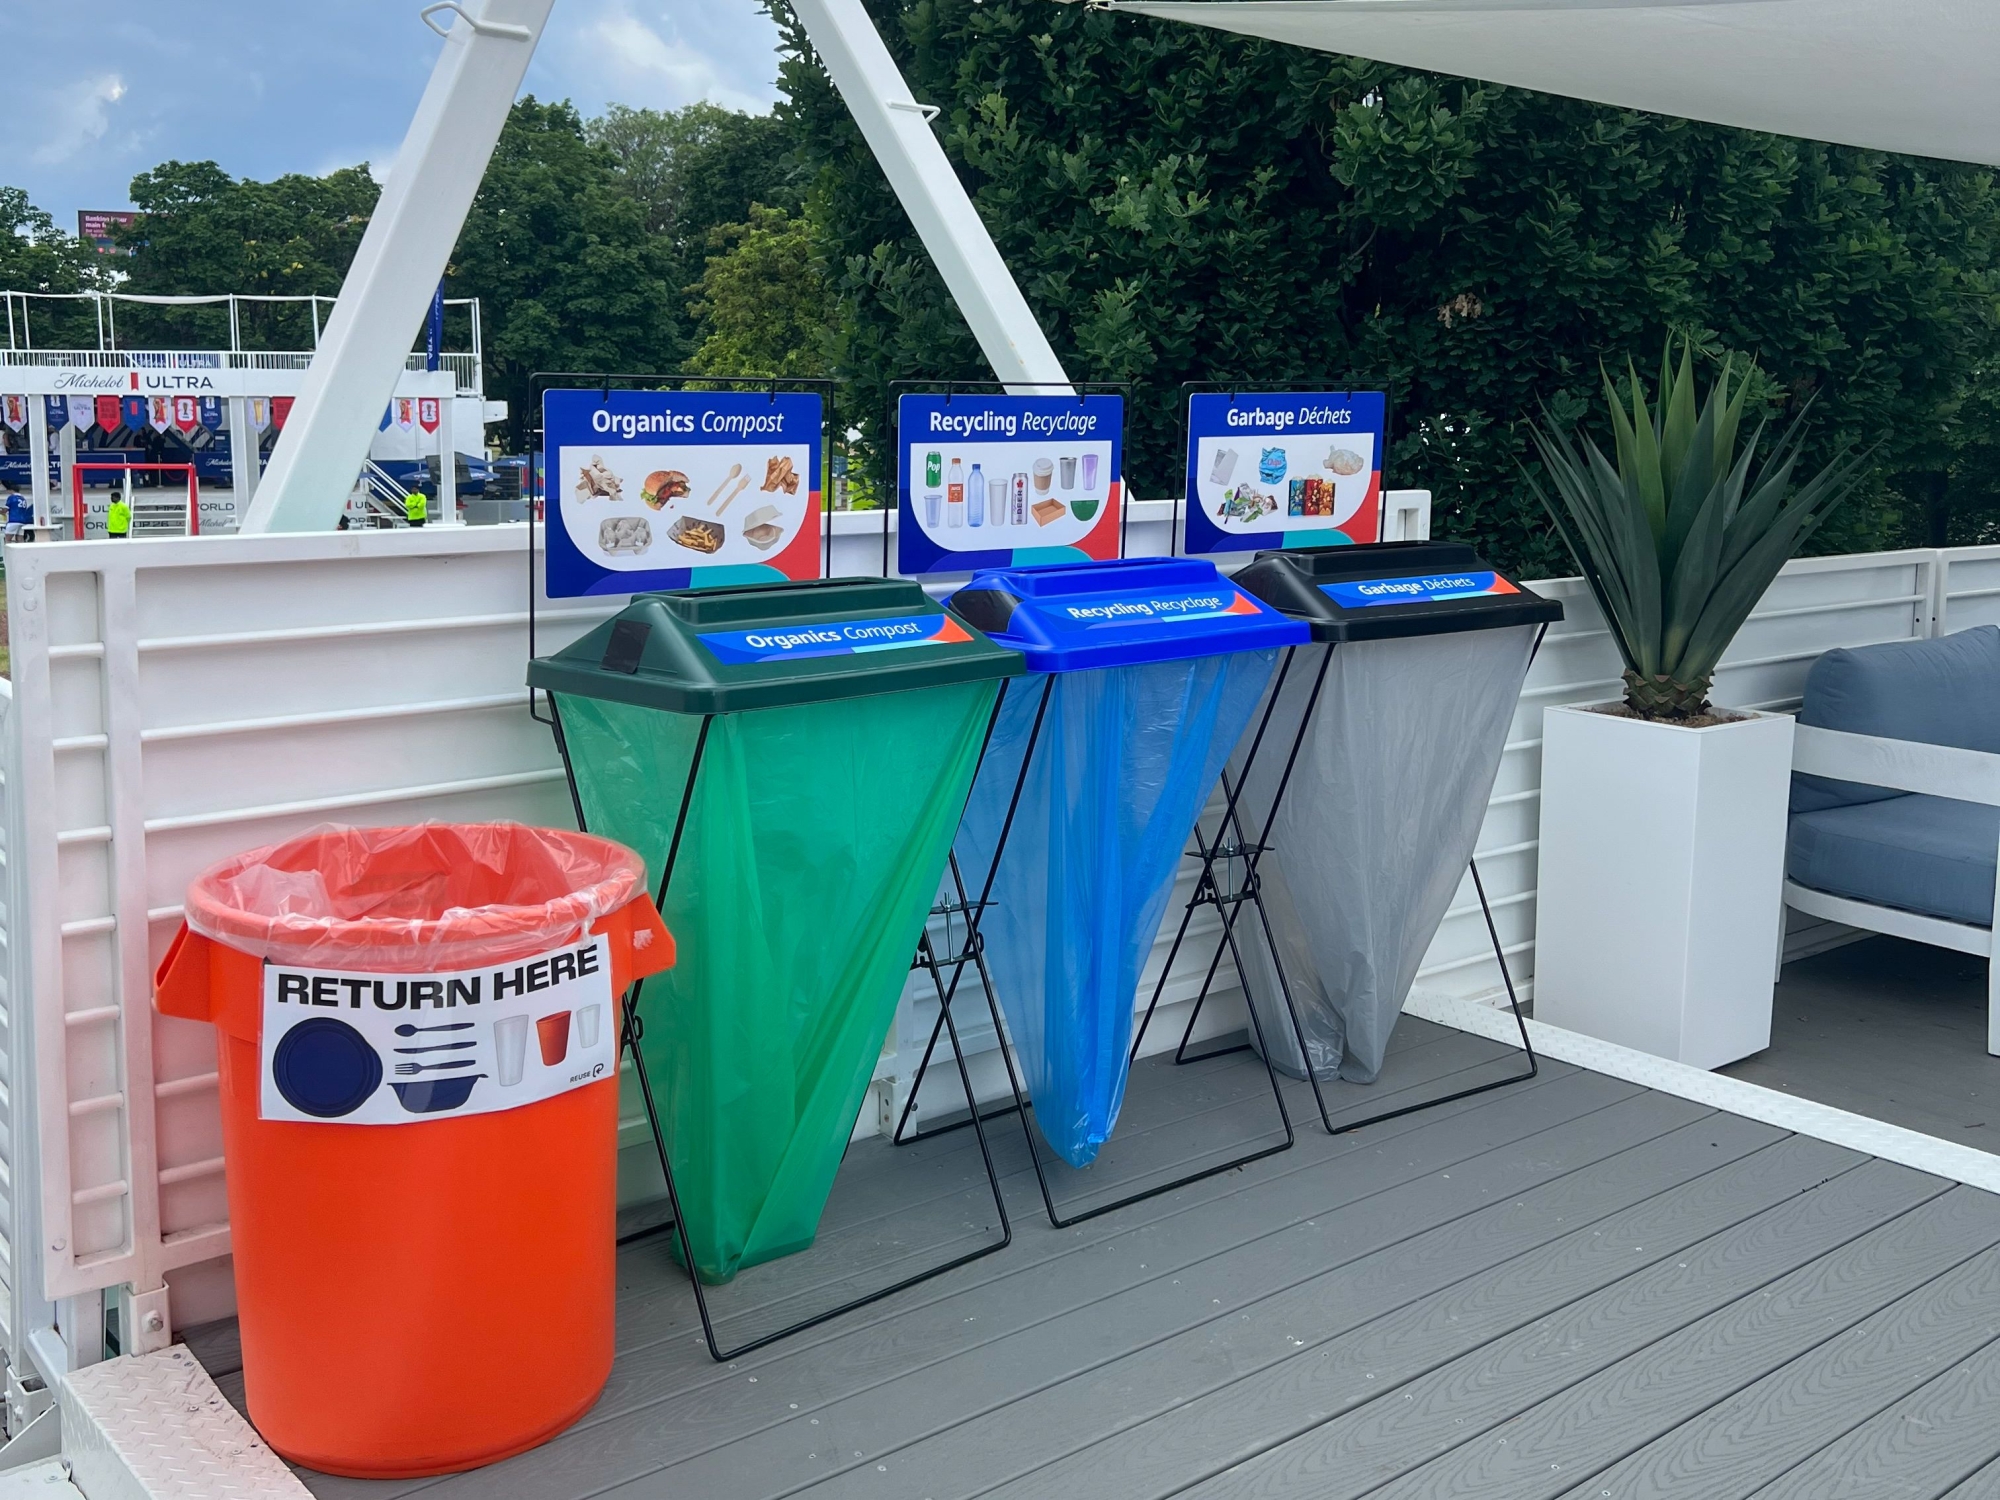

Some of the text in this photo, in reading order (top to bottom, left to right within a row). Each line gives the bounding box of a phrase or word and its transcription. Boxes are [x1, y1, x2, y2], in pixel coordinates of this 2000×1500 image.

[54, 372, 214, 389] Michelob ULTRA
[592, 409, 784, 439] Organics Compost
[930, 411, 1097, 437] Recycling Recyclage
[1227, 406, 1351, 430] Garbage Déchets
[927, 461, 940, 473] Pop
[17, 499, 28, 509] 26
[197, 502, 235, 511] ORLD
[1357, 577, 1476, 595] Garbage Déchets
[1066, 596, 1223, 619] Recycling Recyclage
[745, 620, 923, 650] Organics Compost
[277, 944, 599, 1011] RETURN HERE
[570, 1070, 591, 1083] REUSE
